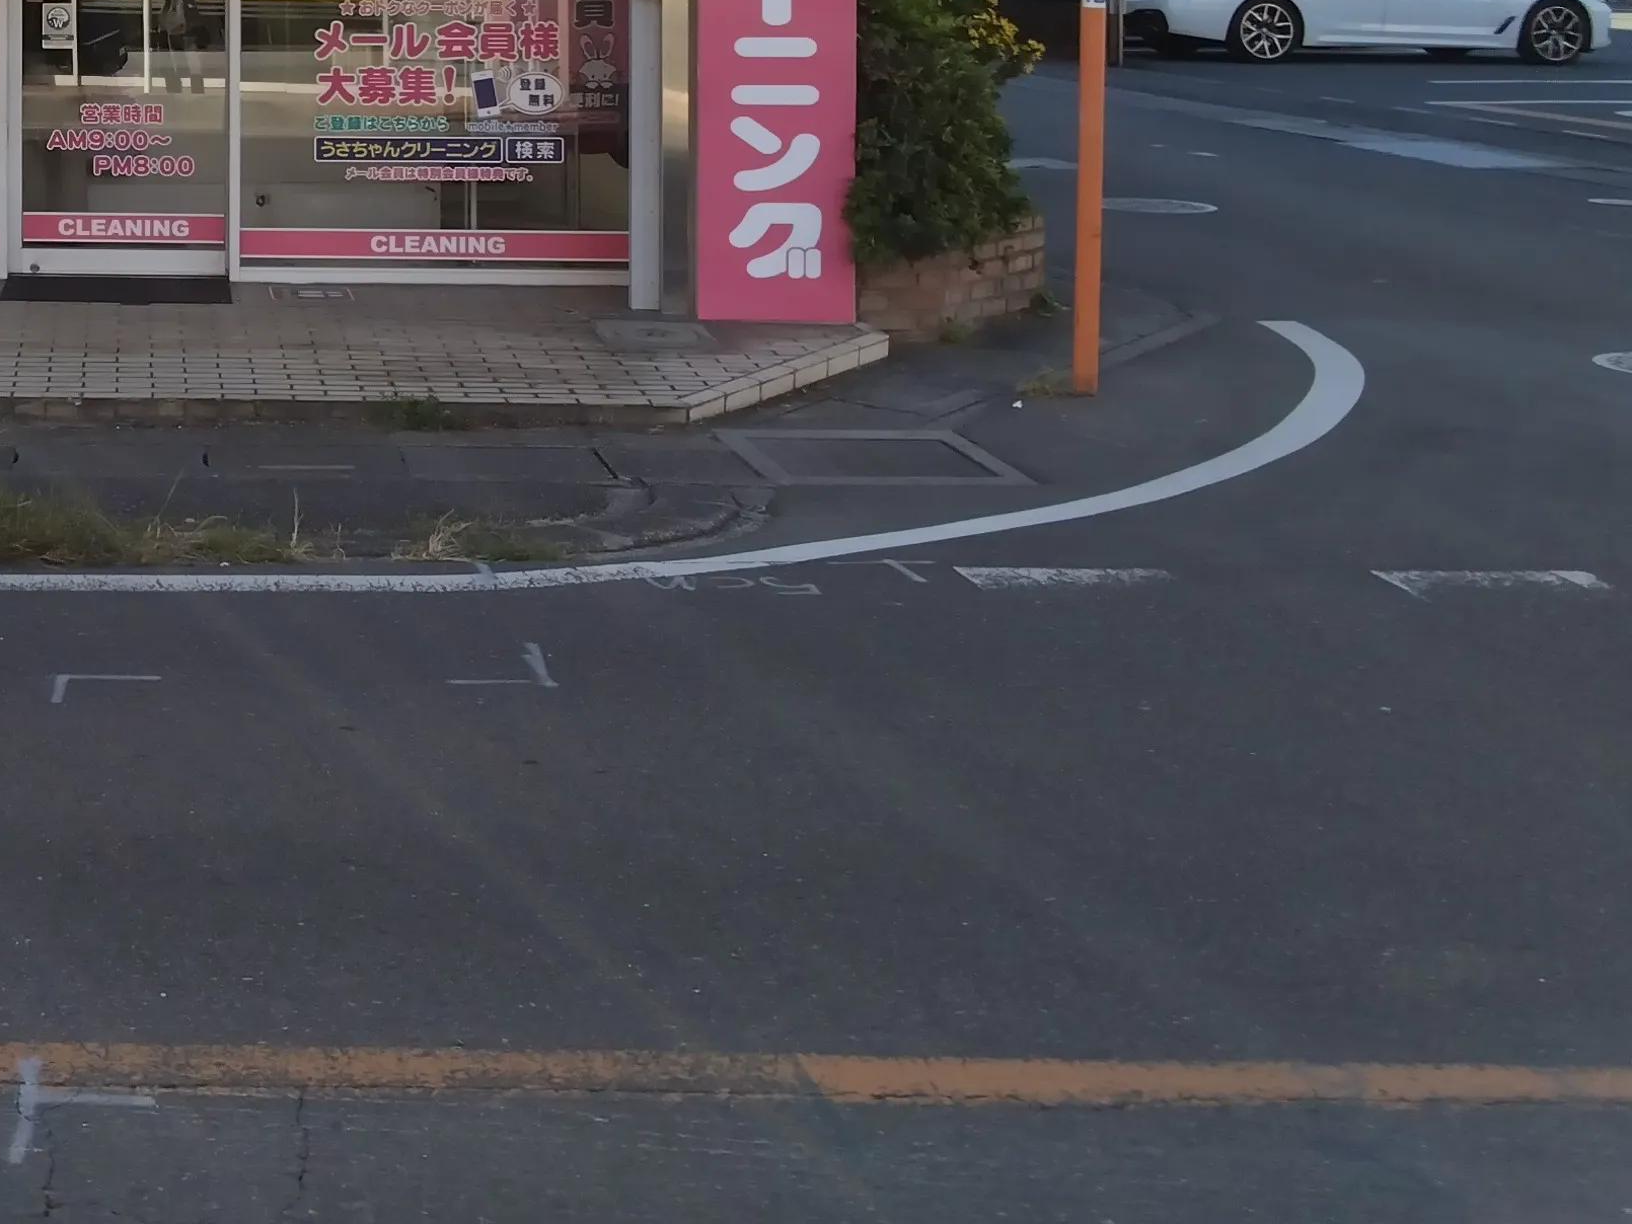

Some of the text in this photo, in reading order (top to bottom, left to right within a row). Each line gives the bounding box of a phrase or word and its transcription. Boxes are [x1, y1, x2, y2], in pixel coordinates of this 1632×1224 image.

[317, 65, 456, 106] 大募集!
[79, 104, 164, 124] 営業時間
[313, 116, 449, 132] ご登録はこちらから
[320, 140, 497, 159] うさちゃんクリーニング
[515, 140, 555, 159] 検索
[93, 155, 195, 177] PM8:00
[58, 218, 190, 237] CLEANING
[371, 235, 506, 254] CLEANING
